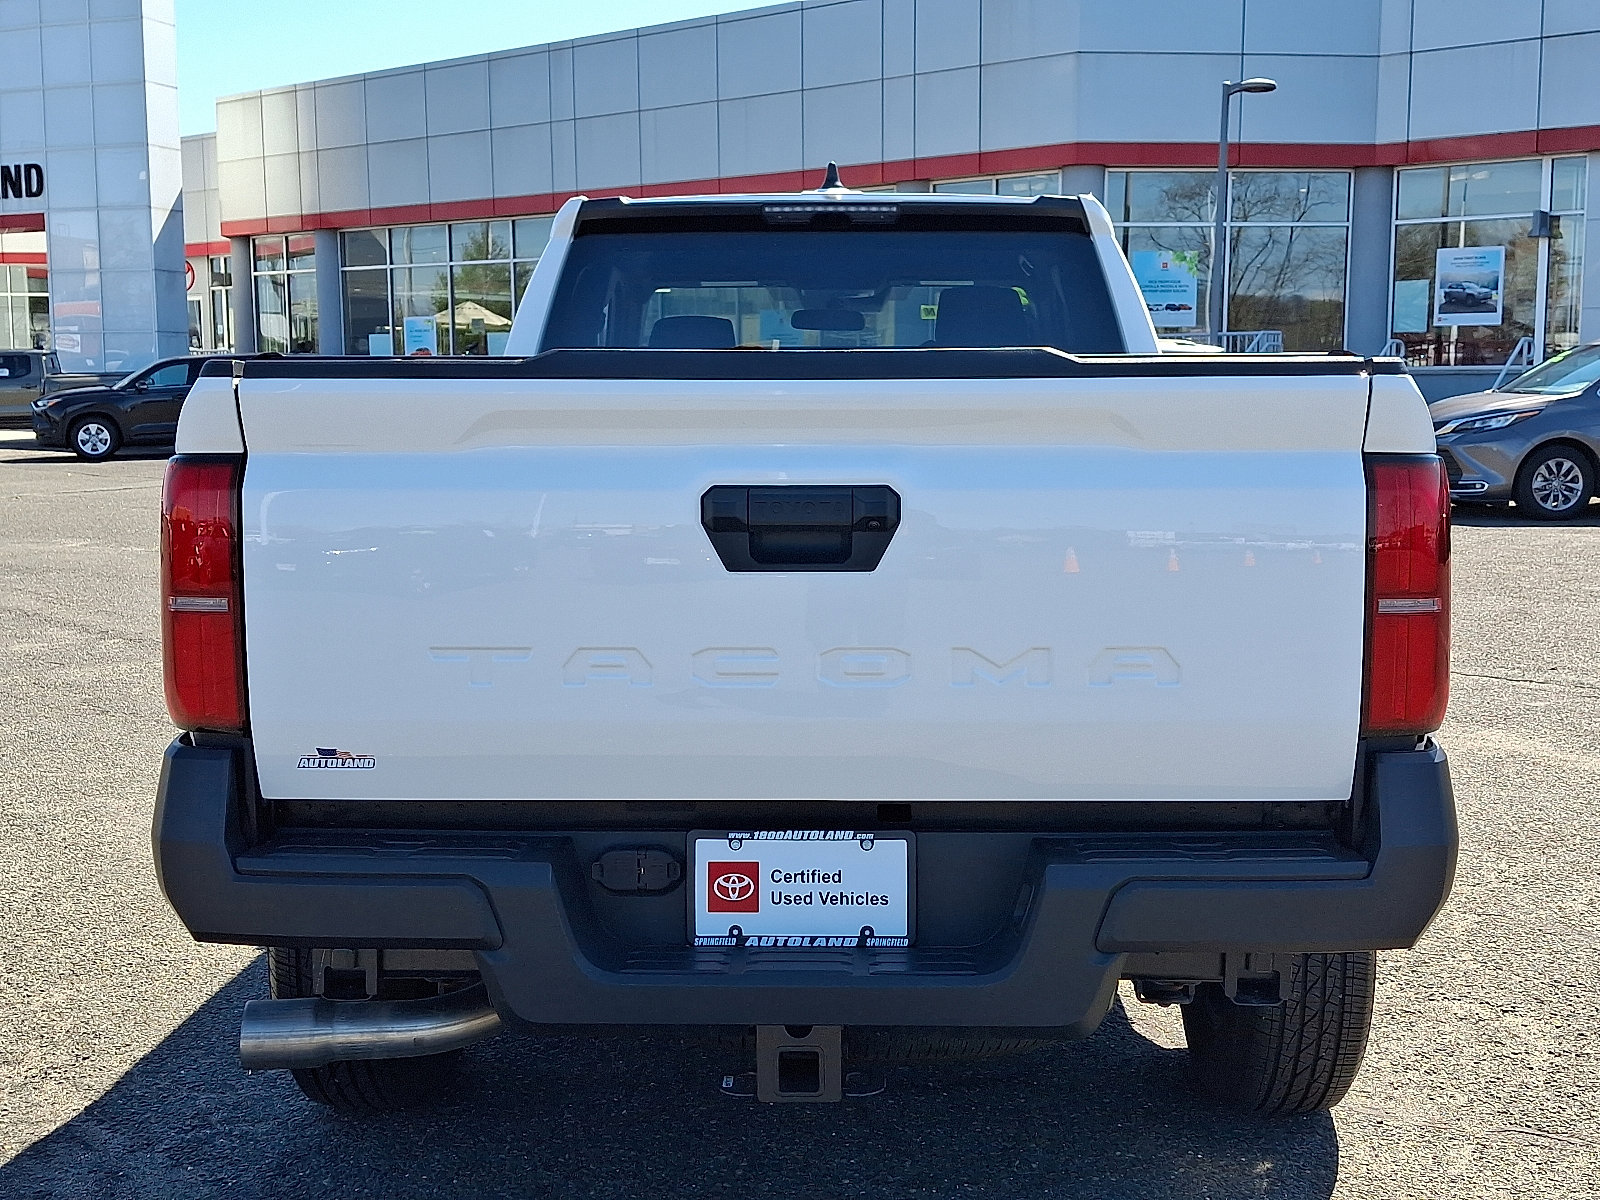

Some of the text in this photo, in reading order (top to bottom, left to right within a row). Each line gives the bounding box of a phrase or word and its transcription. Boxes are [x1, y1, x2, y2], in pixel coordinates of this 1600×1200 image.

[0, 163, 44, 199] ND
[428, 646, 1182, 687] TACOMA
[298, 758, 375, 768] AUTOLAND
[727, 830, 875, 840] www.1800AUTOLAND.com
[770, 869, 843, 884] Certified
[770, 890, 890, 906] Used Vehicles
[694, 936, 909, 947] SPRINGFIELD AUTOLAND SPRINGFIELD
